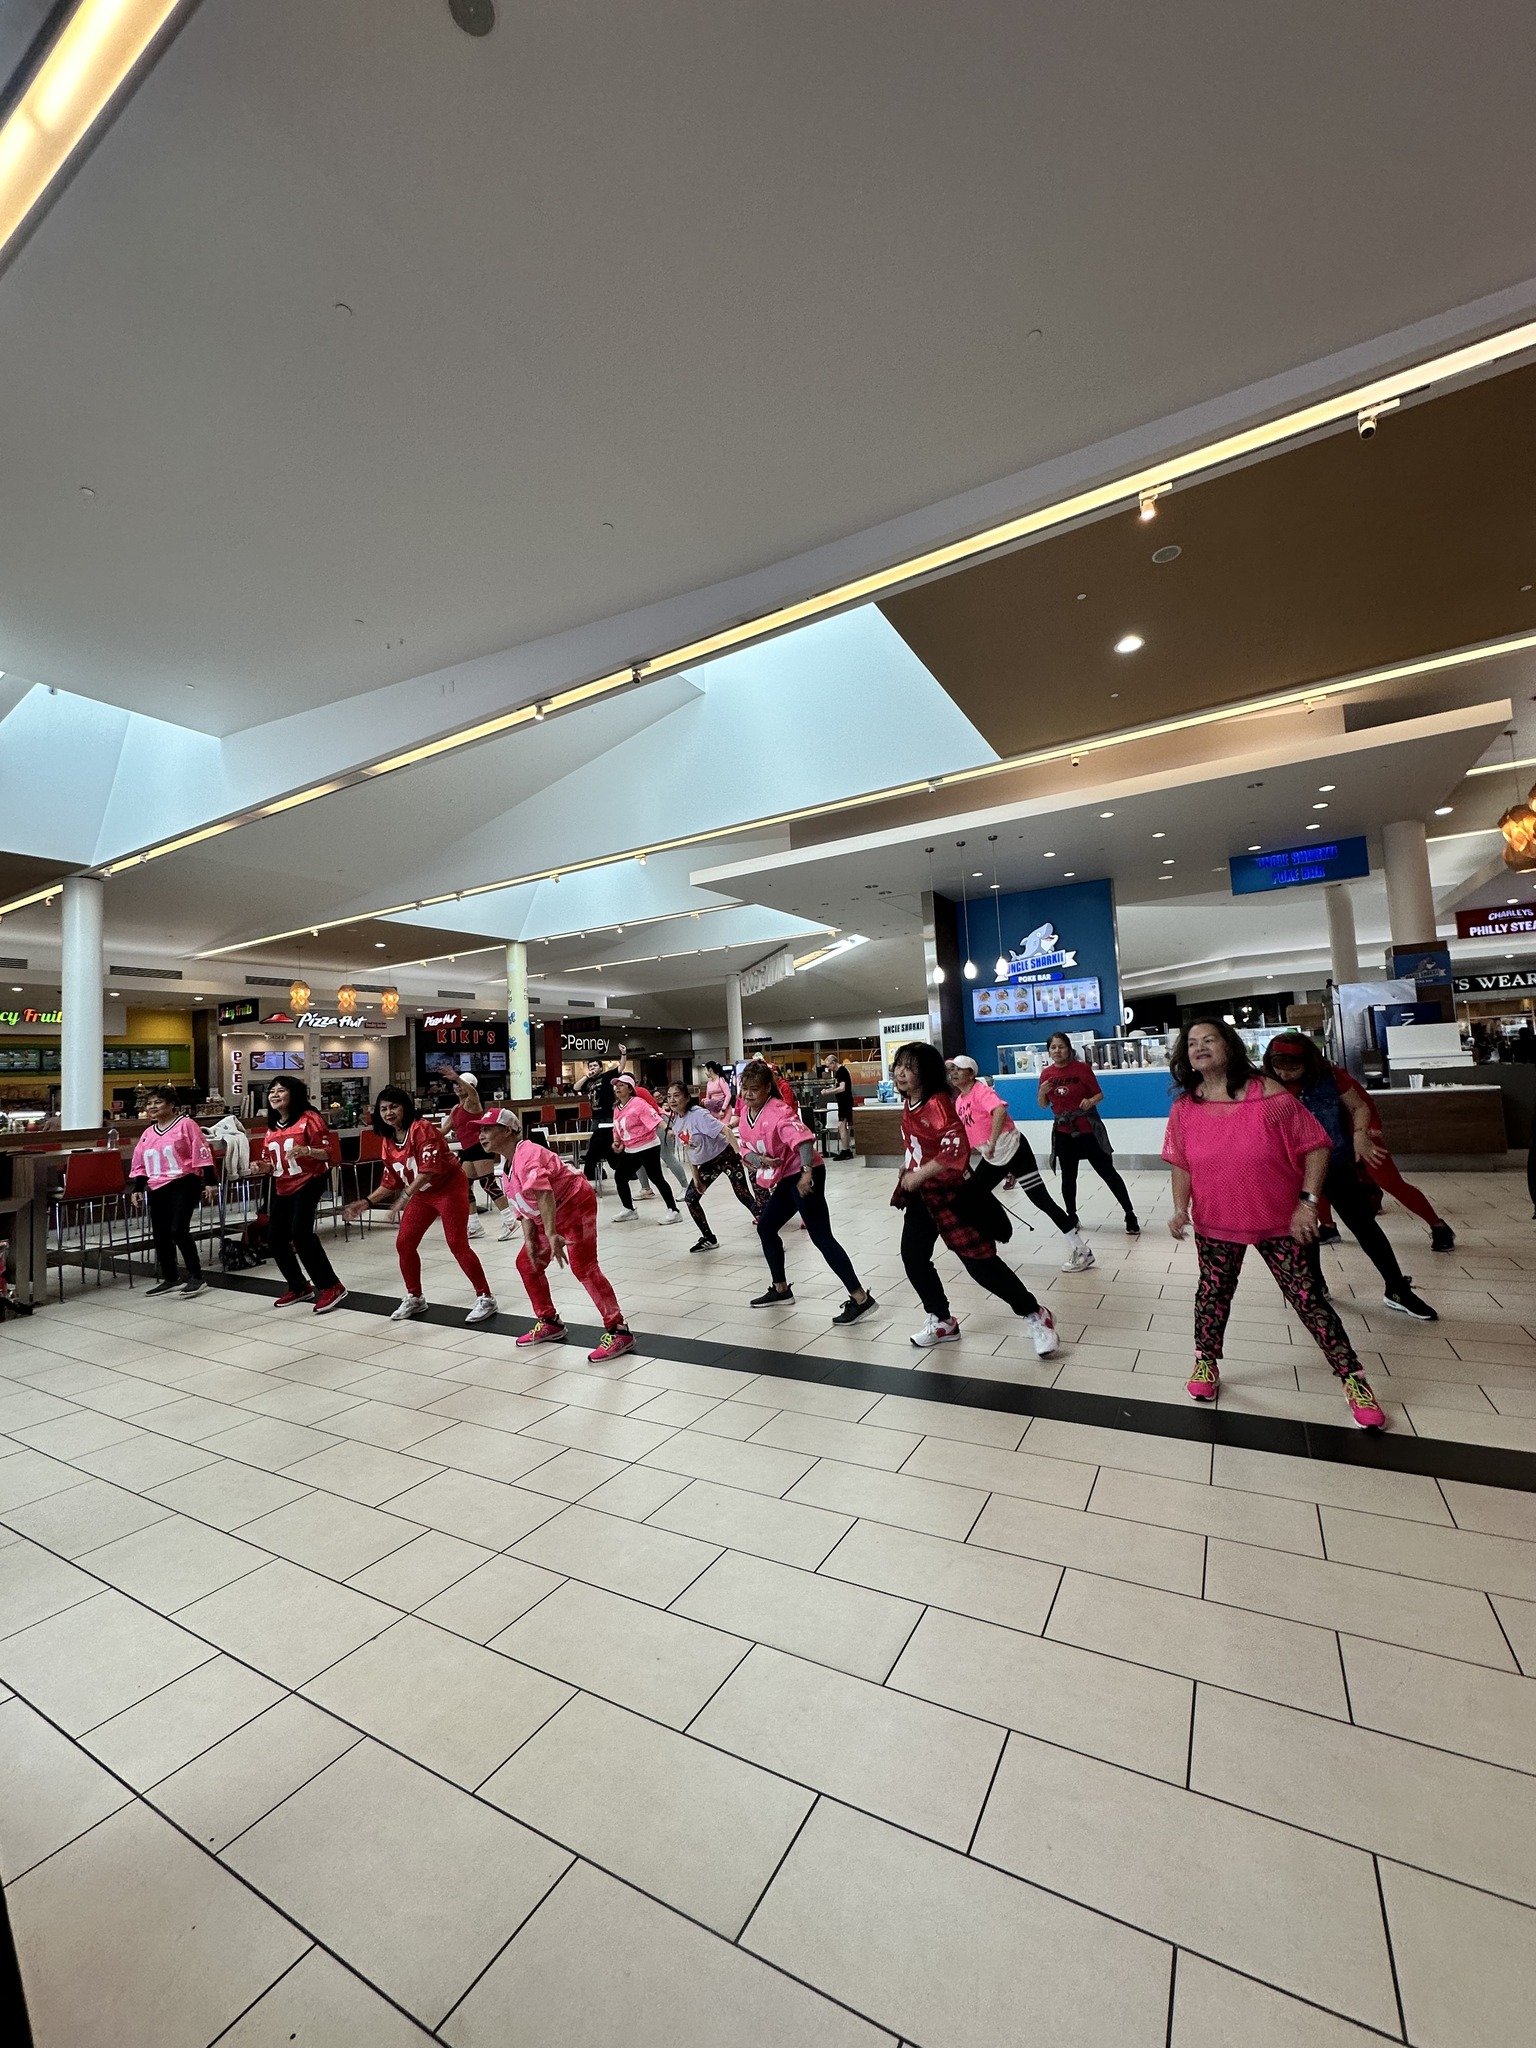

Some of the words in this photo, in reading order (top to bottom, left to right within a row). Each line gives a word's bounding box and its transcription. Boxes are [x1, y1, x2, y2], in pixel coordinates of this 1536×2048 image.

[1488, 908, 1534, 920] CHARLEYS
[1469, 923, 1509, 936] PHILLY
[1030, 952, 1065, 970] SHARKII
[1018, 975, 1037, 983] POKE
[1037, 973, 1051, 981] BAR
[1475, 972, 1536, 989] WEAR
[24, 1008, 63, 1023] Fruit
[297, 1012, 338, 1029] Pizza
[338, 1015, 367, 1028] Hut
[424, 1016, 443, 1028] Pizza
[443, 1013, 458, 1025] Hut
[436, 1028, 496, 1045] KIKI'S
[883, 1024, 900, 1034] UNCLE
[560, 1034, 610, 1053] CPenney
[233, 1050, 243, 1095] PIES
